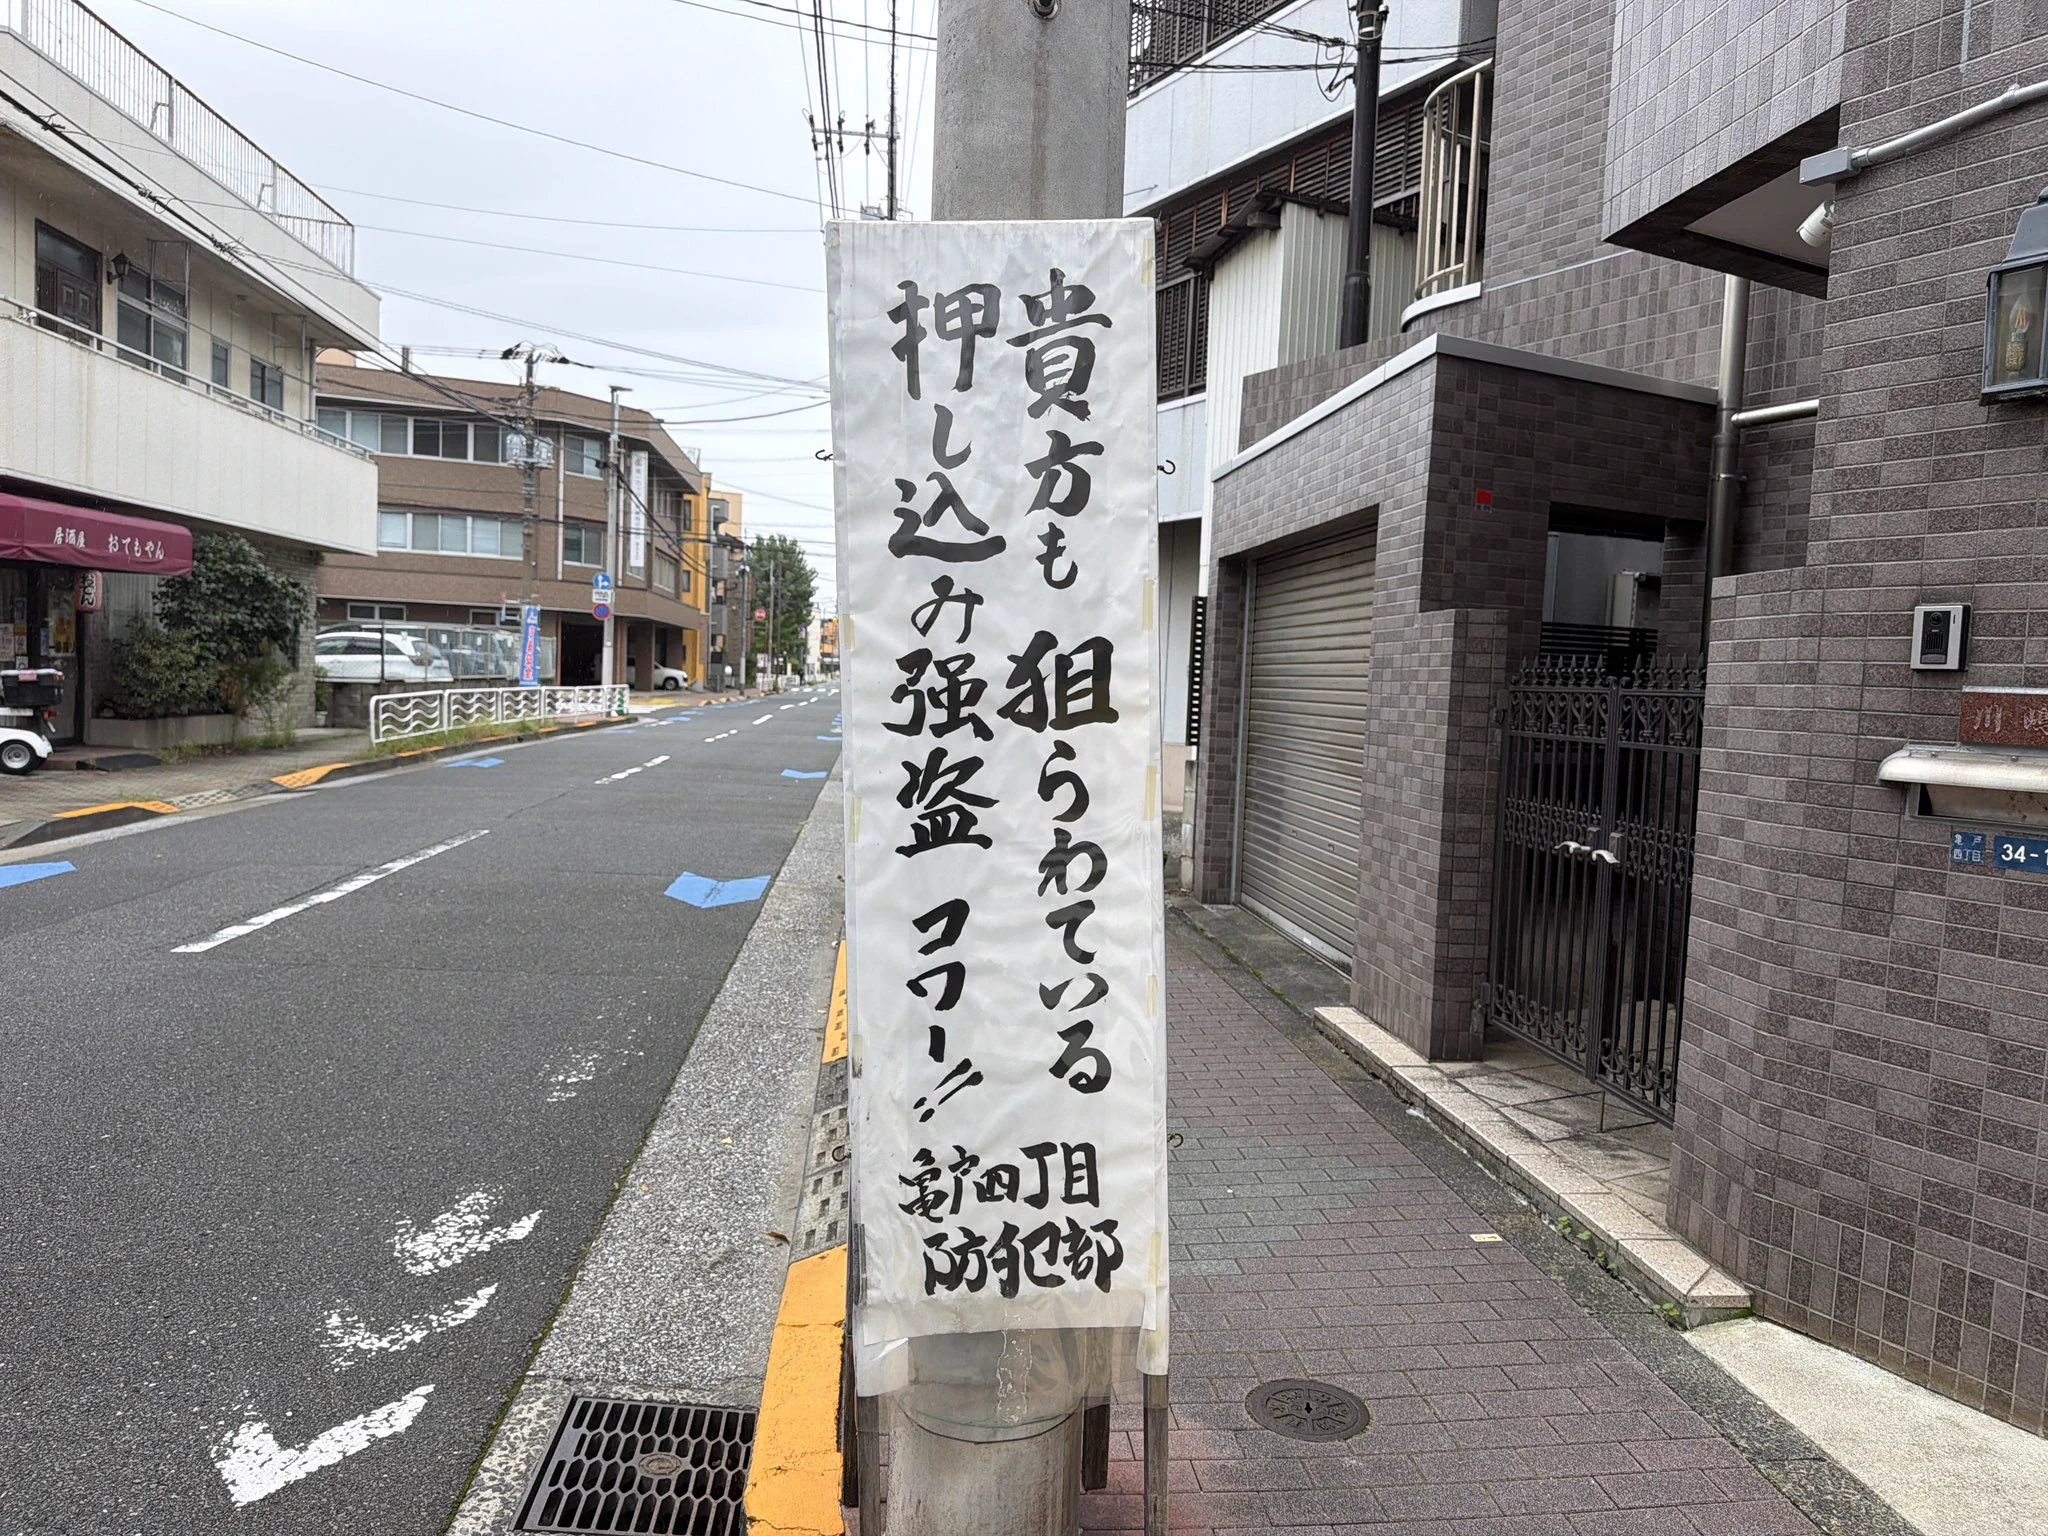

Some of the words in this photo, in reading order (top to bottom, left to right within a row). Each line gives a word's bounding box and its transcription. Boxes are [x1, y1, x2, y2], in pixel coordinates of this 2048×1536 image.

[54, 526, 85, 549] 居酒屋
[108, 533, 164, 560] おてもやん
[1953, 848, 1982, 862] 四丁目
[1954, 832, 1983, 847] 亀戸
[899, 1141, 1099, 1224] 亀戸四丁目
[922, 1217, 1124, 1299] 防犯部
